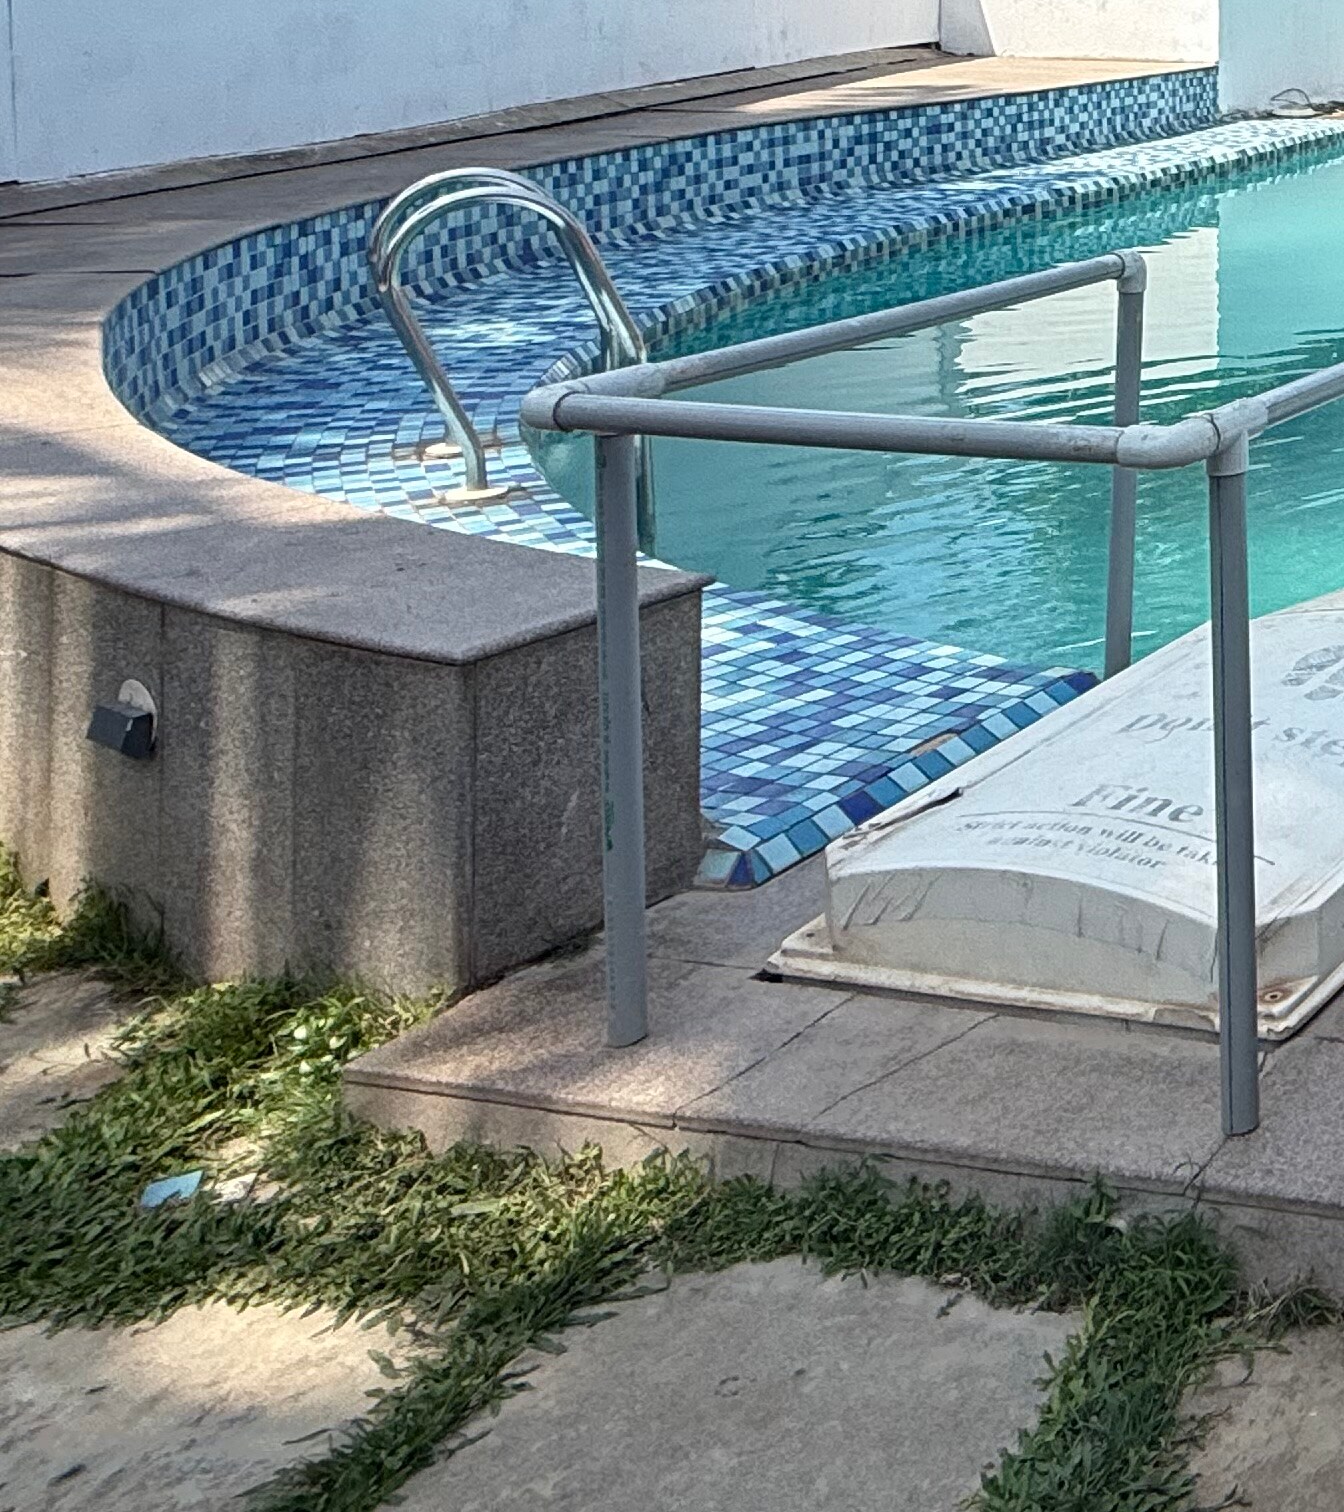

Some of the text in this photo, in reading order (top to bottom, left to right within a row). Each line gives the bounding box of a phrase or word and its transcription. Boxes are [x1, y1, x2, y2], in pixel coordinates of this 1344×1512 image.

[1071, 784, 1204, 822] Fine
[1101, 828, 1143, 844] will
[1143, 835, 1172, 851] be
[1176, 845, 1217, 866] tak
